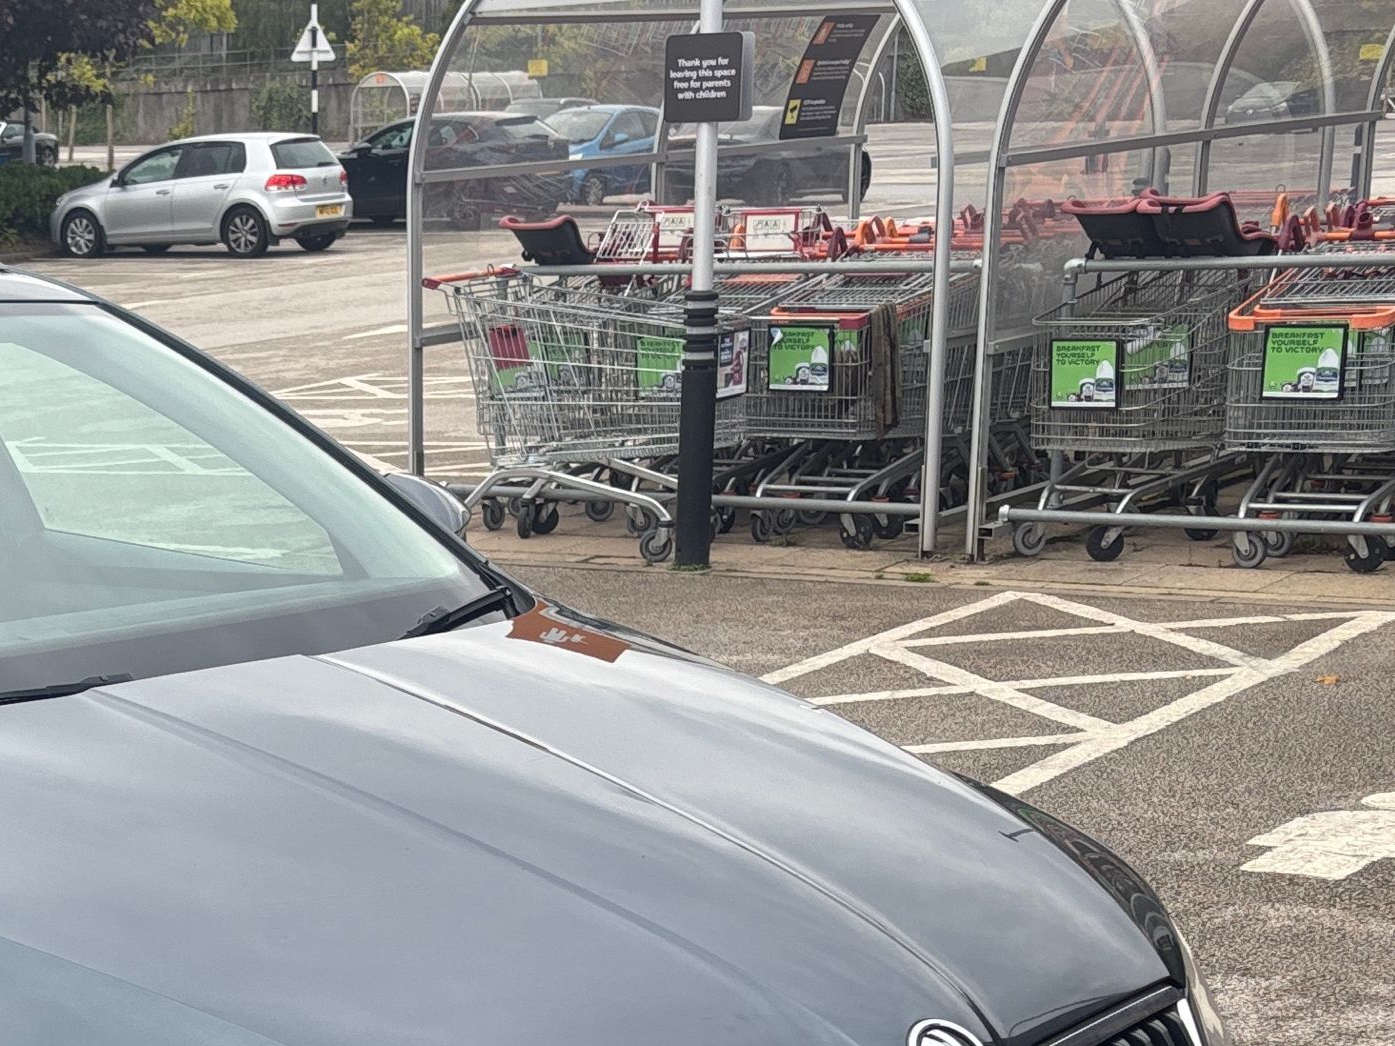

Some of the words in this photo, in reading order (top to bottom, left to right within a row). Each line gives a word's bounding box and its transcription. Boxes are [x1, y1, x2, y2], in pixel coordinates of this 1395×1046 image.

[677, 58, 701, 68] Thank
[702, 59, 717, 69] you
[718, 57, 730, 66] for
[670, 70, 697, 80] leaving
[699, 69, 713, 77] this
[714, 69, 736, 78] space
[674, 80, 689, 89] free
[690, 80, 701, 89] for
[702, 79, 731, 90] parents
[677, 91, 695, 99] with
[696, 90, 727, 99] children
[1272, 332, 1326, 340] BREAKFAST
[1285, 346, 1324, 354] VICTORY
[1056, 358, 1066, 366] TO
[1068, 358, 1101, 366] VICTORY
